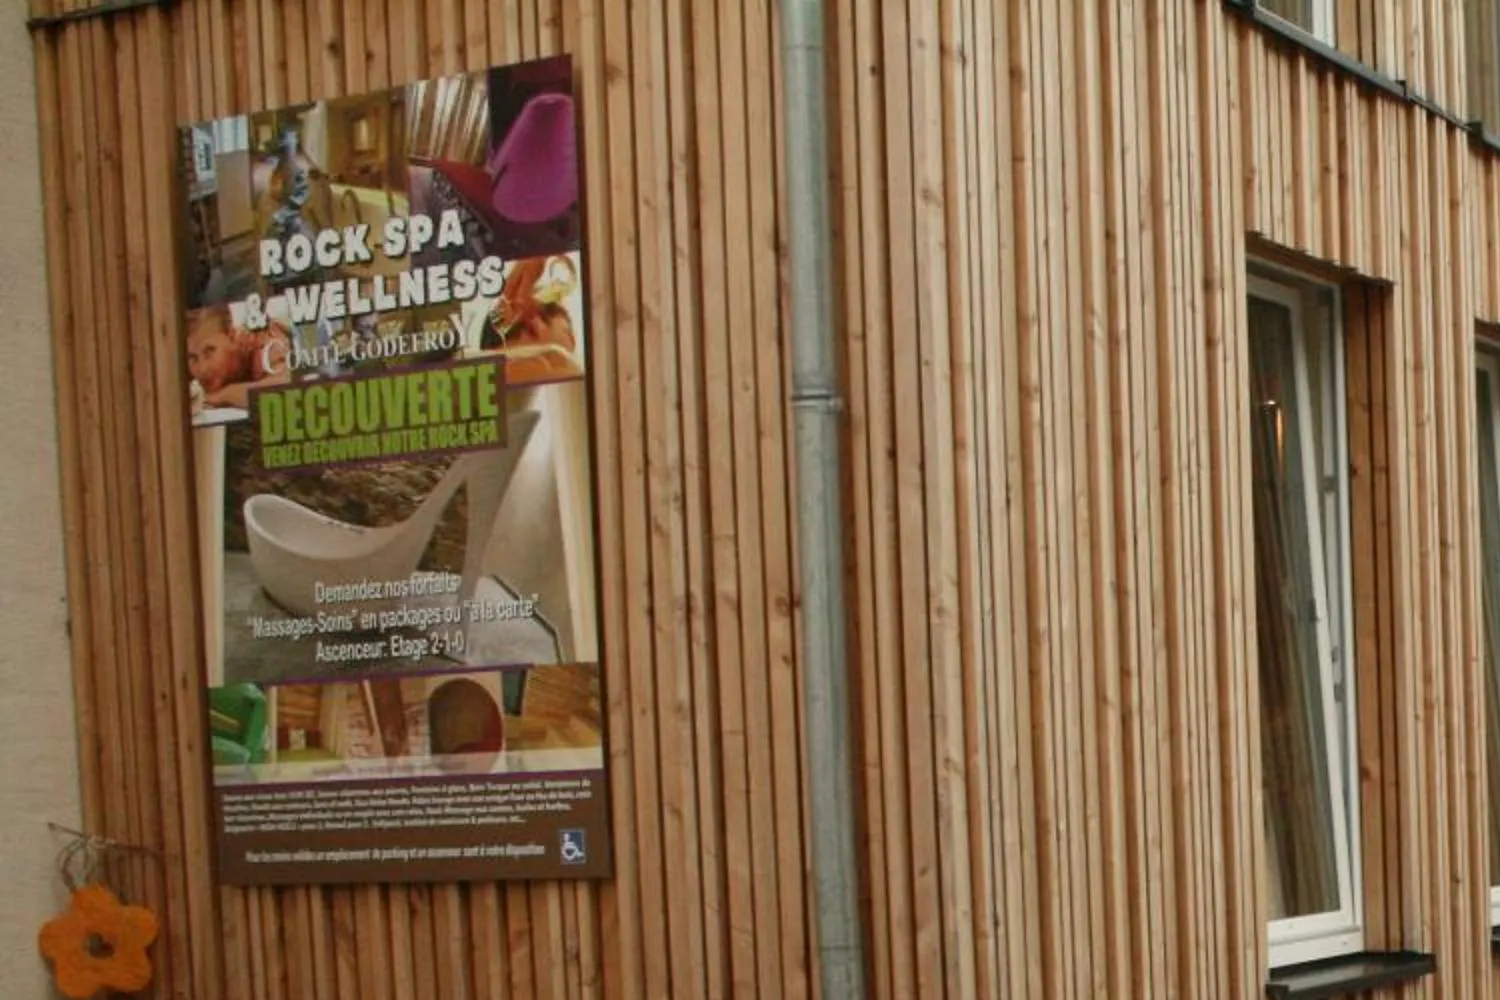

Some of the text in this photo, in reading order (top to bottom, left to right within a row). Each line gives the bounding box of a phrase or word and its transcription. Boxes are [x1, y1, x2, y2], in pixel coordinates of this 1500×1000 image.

[259, 208, 466, 278] ROCK SPA
[244, 254, 505, 331] & WELLNESS
[259, 362, 499, 445] DECOUVERTE
[314, 578, 382, 604] Demandez
[384, 580, 409, 598] nos
[359, 611, 377, 630] en
[379, 604, 441, 633] packages
[446, 605, 462, 623] ou
